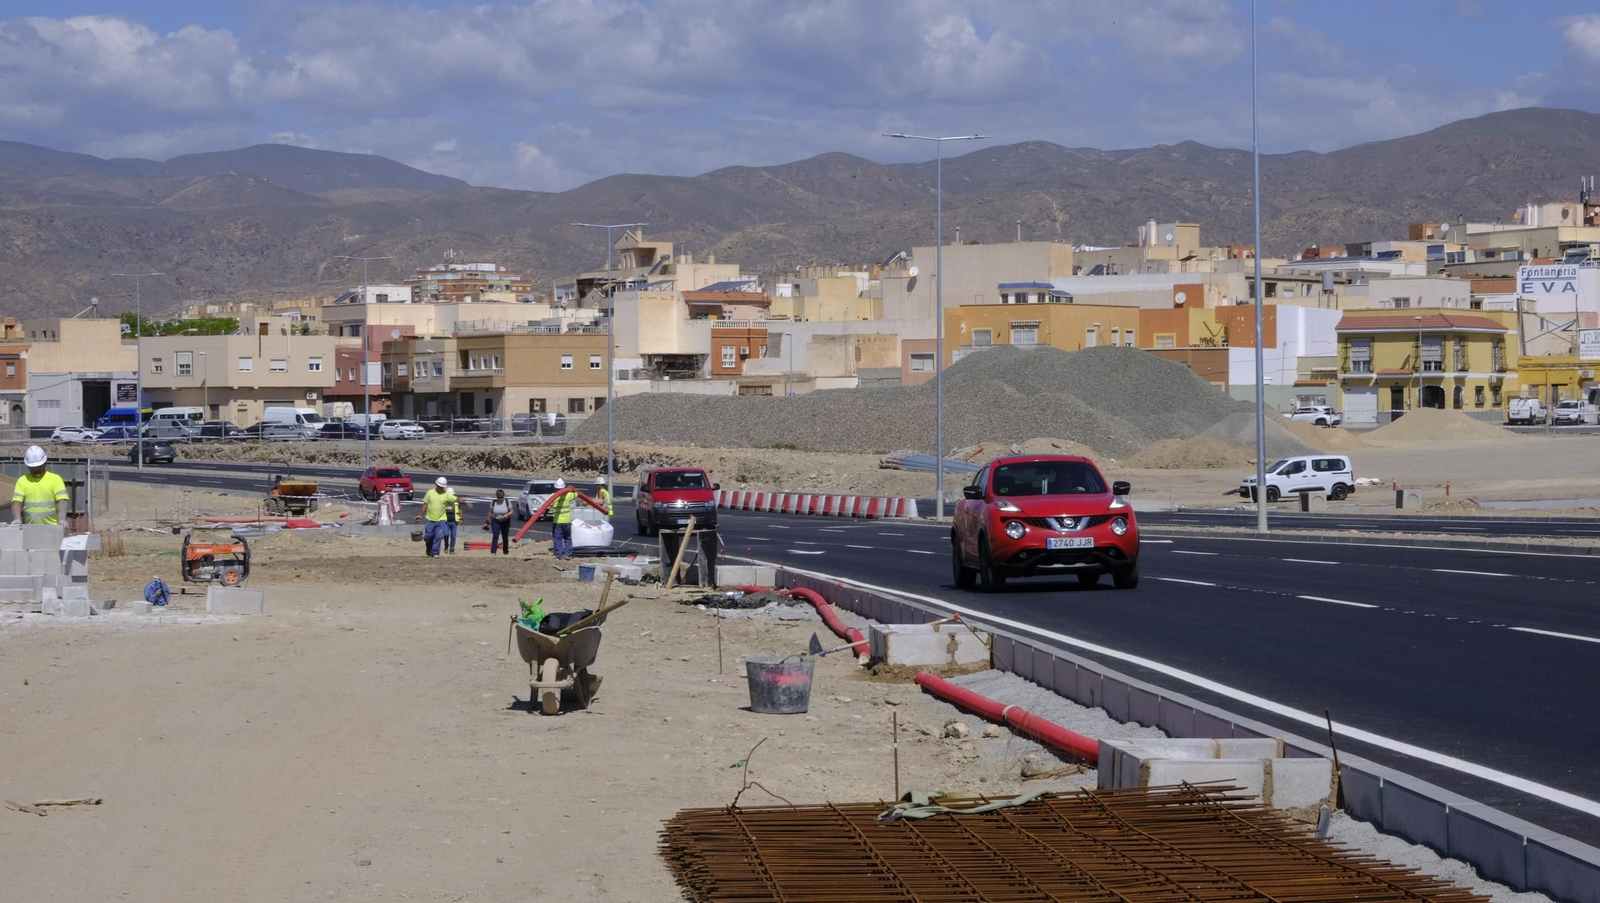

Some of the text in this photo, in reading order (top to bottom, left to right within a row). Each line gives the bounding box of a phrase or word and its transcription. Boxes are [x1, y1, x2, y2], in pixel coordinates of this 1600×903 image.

[1521, 266, 1577, 277] Fontanería
[1521, 281, 1576, 294] EVA
[1053, 538, 1092, 547] 2740 JJR
